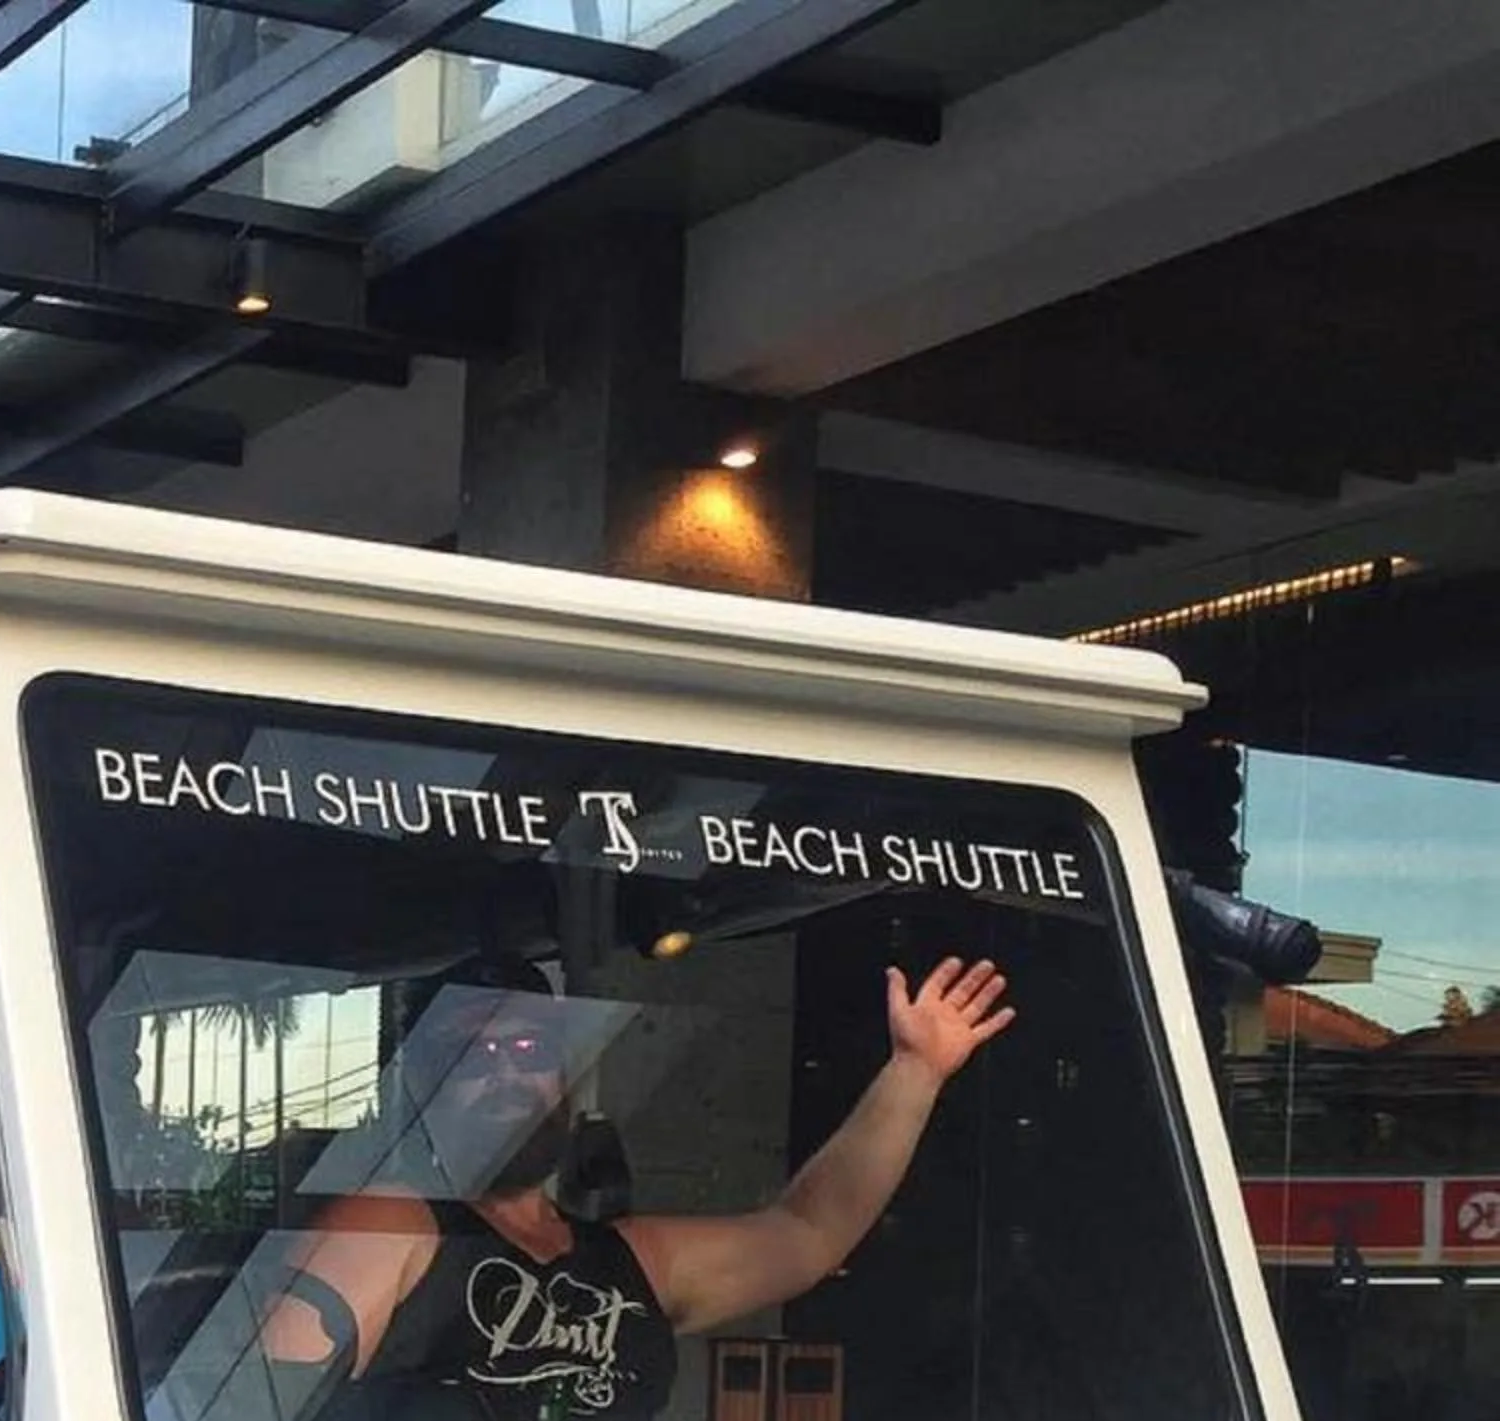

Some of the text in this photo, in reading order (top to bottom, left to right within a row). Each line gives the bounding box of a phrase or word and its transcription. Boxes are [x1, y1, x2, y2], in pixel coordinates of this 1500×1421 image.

[95, 748, 297, 820] BEACH
[313, 772, 551, 846] SHUTTLE
[700, 814, 870, 879] BEACH
[881, 834, 1085, 899] SHUTTLE
